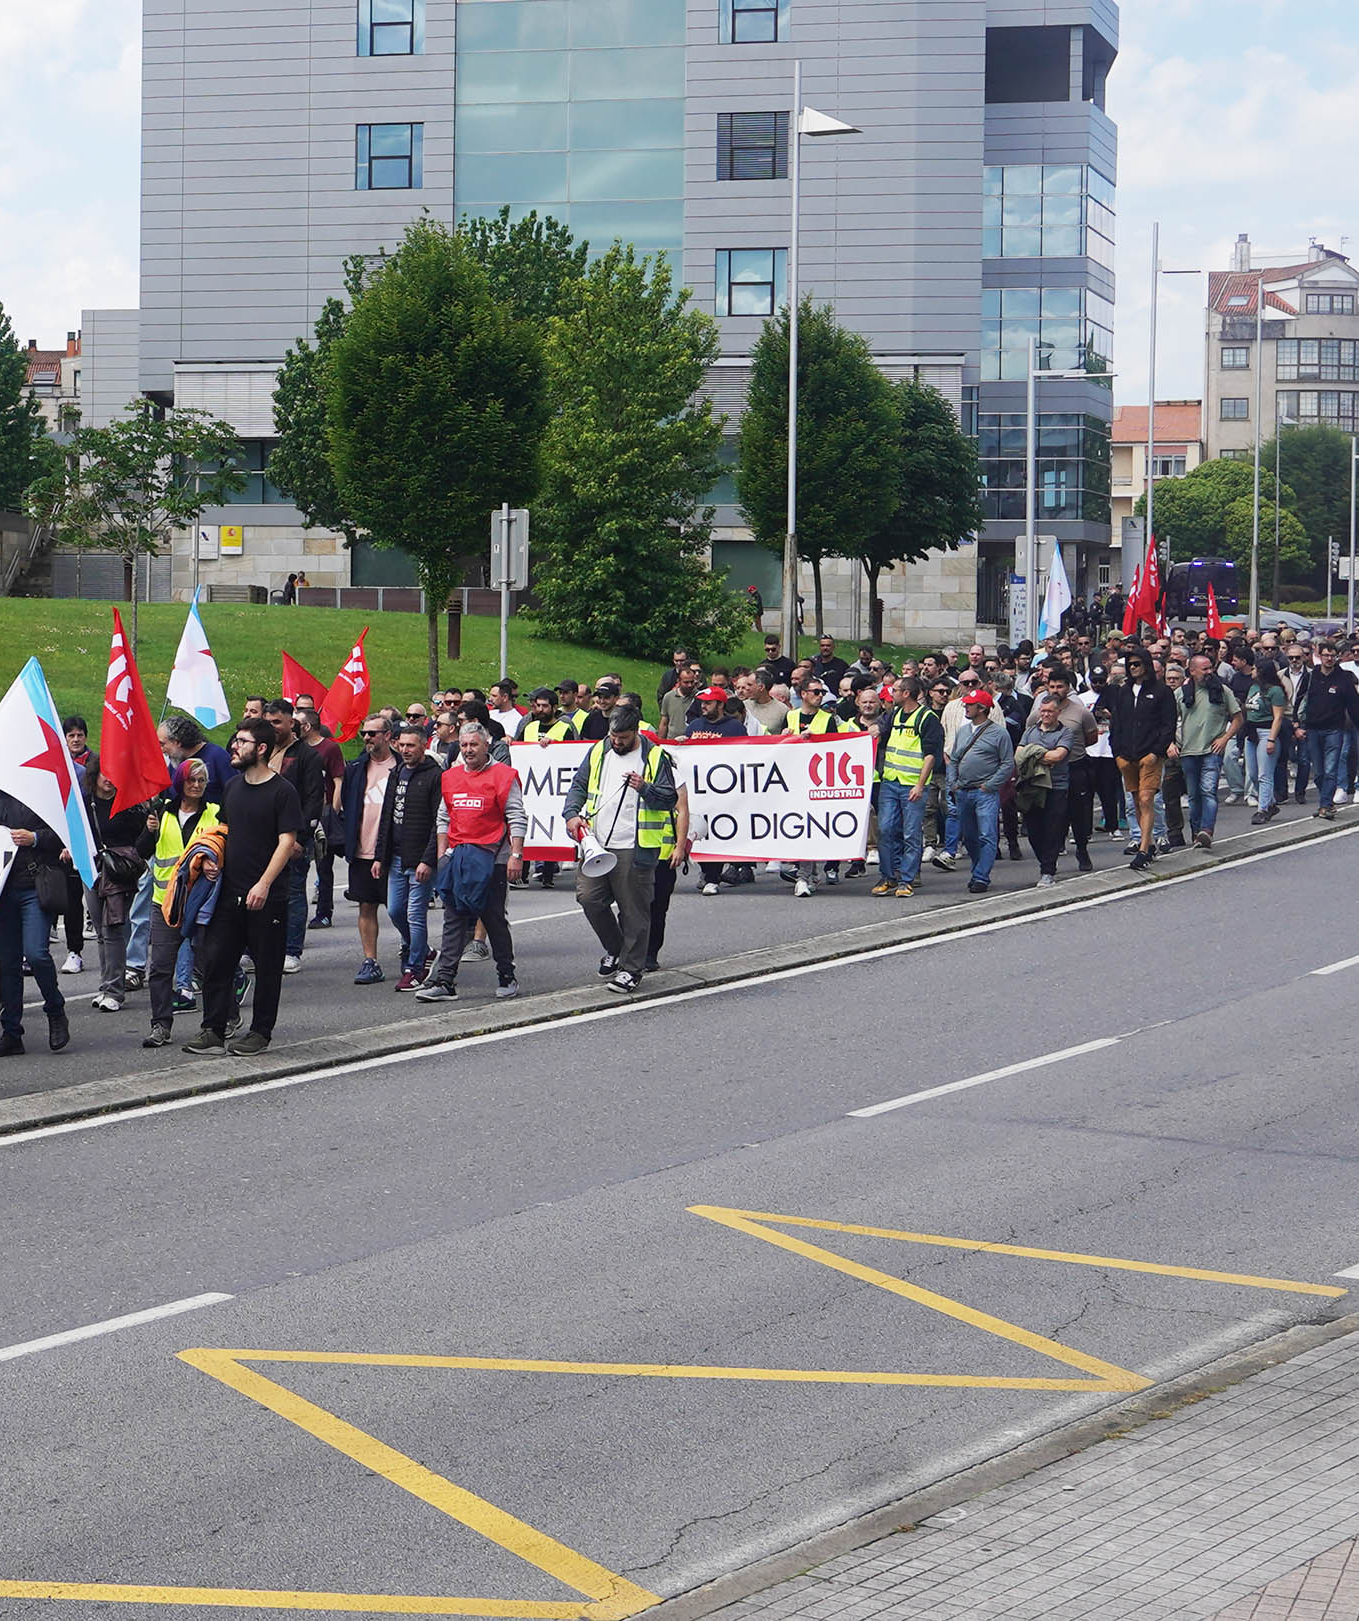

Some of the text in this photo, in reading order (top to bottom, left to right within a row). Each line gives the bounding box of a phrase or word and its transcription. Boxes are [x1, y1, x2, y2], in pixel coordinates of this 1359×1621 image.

[693, 760, 790, 795] LOITA
[808, 752, 865, 788] CIG
[453, 799, 482, 808] CCOO
[810, 789, 863, 799] INDUSTRIA
[750, 810, 859, 841] DIGNO
